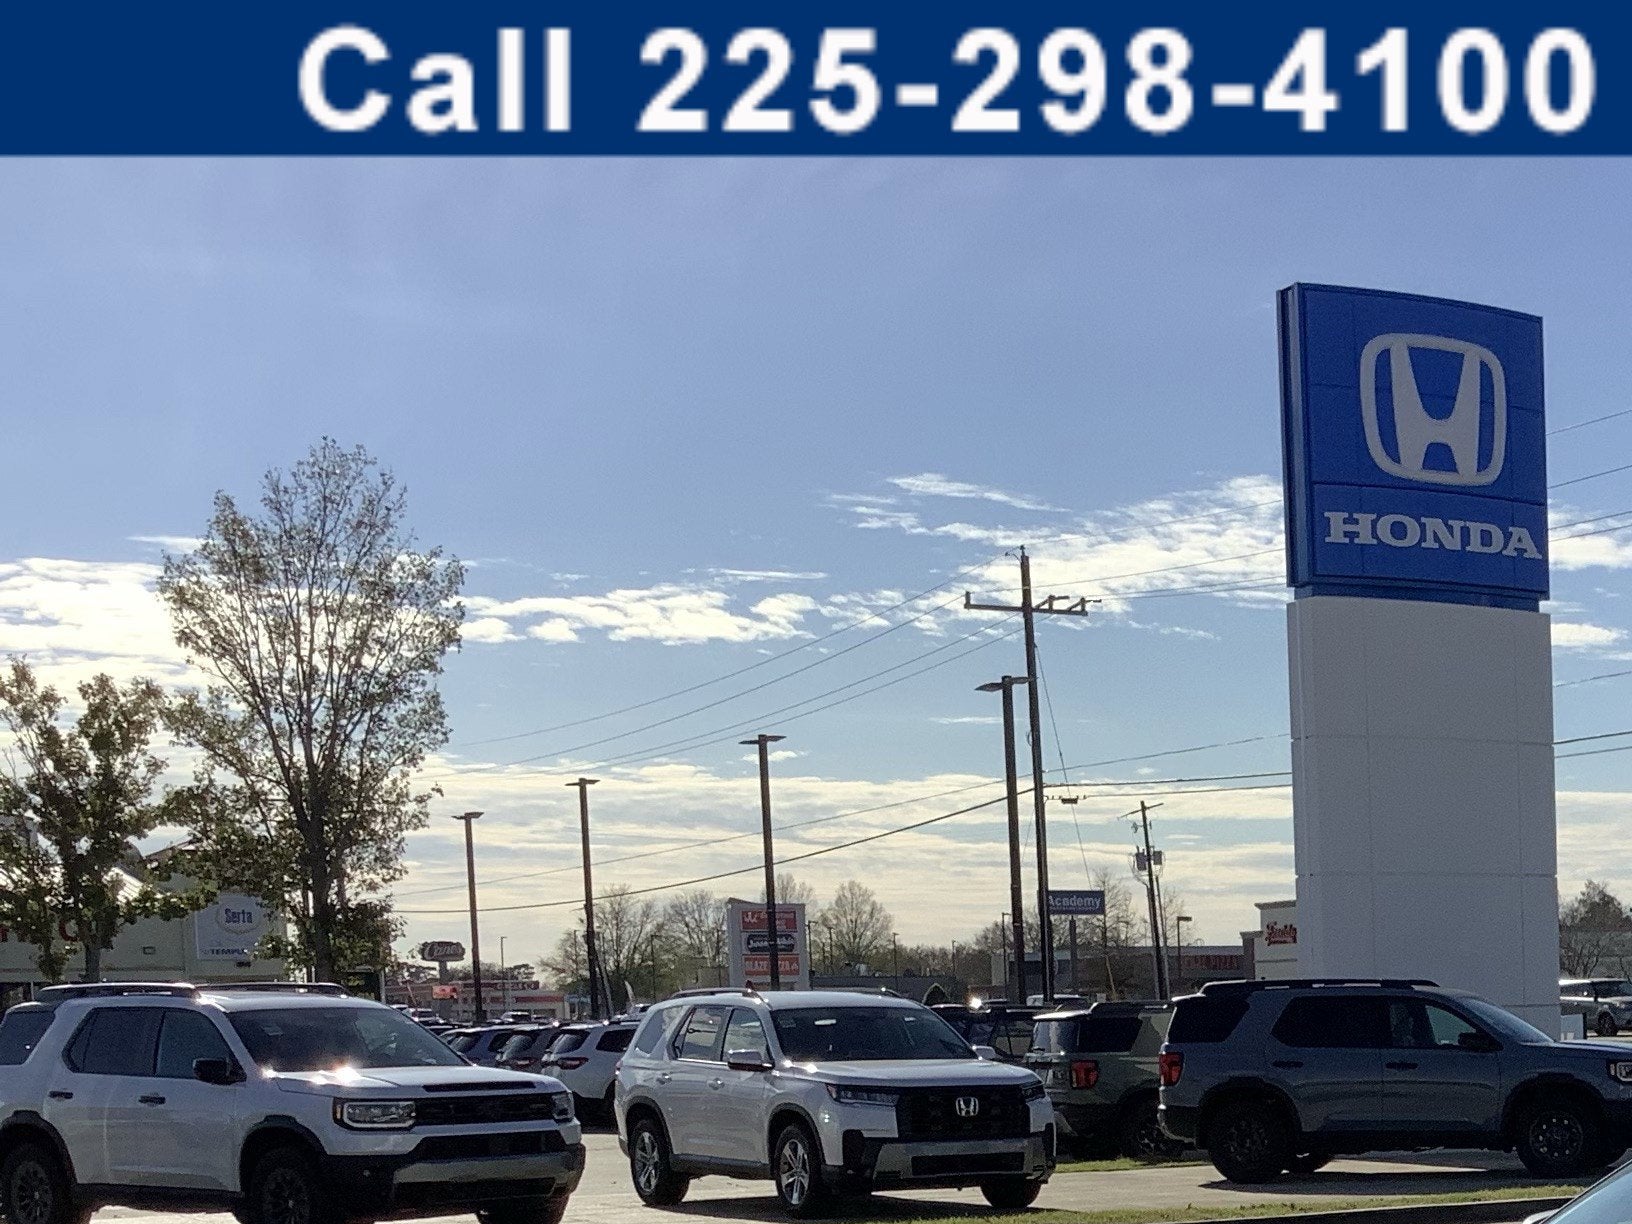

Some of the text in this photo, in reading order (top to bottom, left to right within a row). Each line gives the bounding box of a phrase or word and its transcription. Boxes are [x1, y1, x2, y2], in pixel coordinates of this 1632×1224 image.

[1323, 511, 1543, 560] HONDA
[1048, 895, 1101, 909] Academy
[224, 908, 253, 924] Serta
